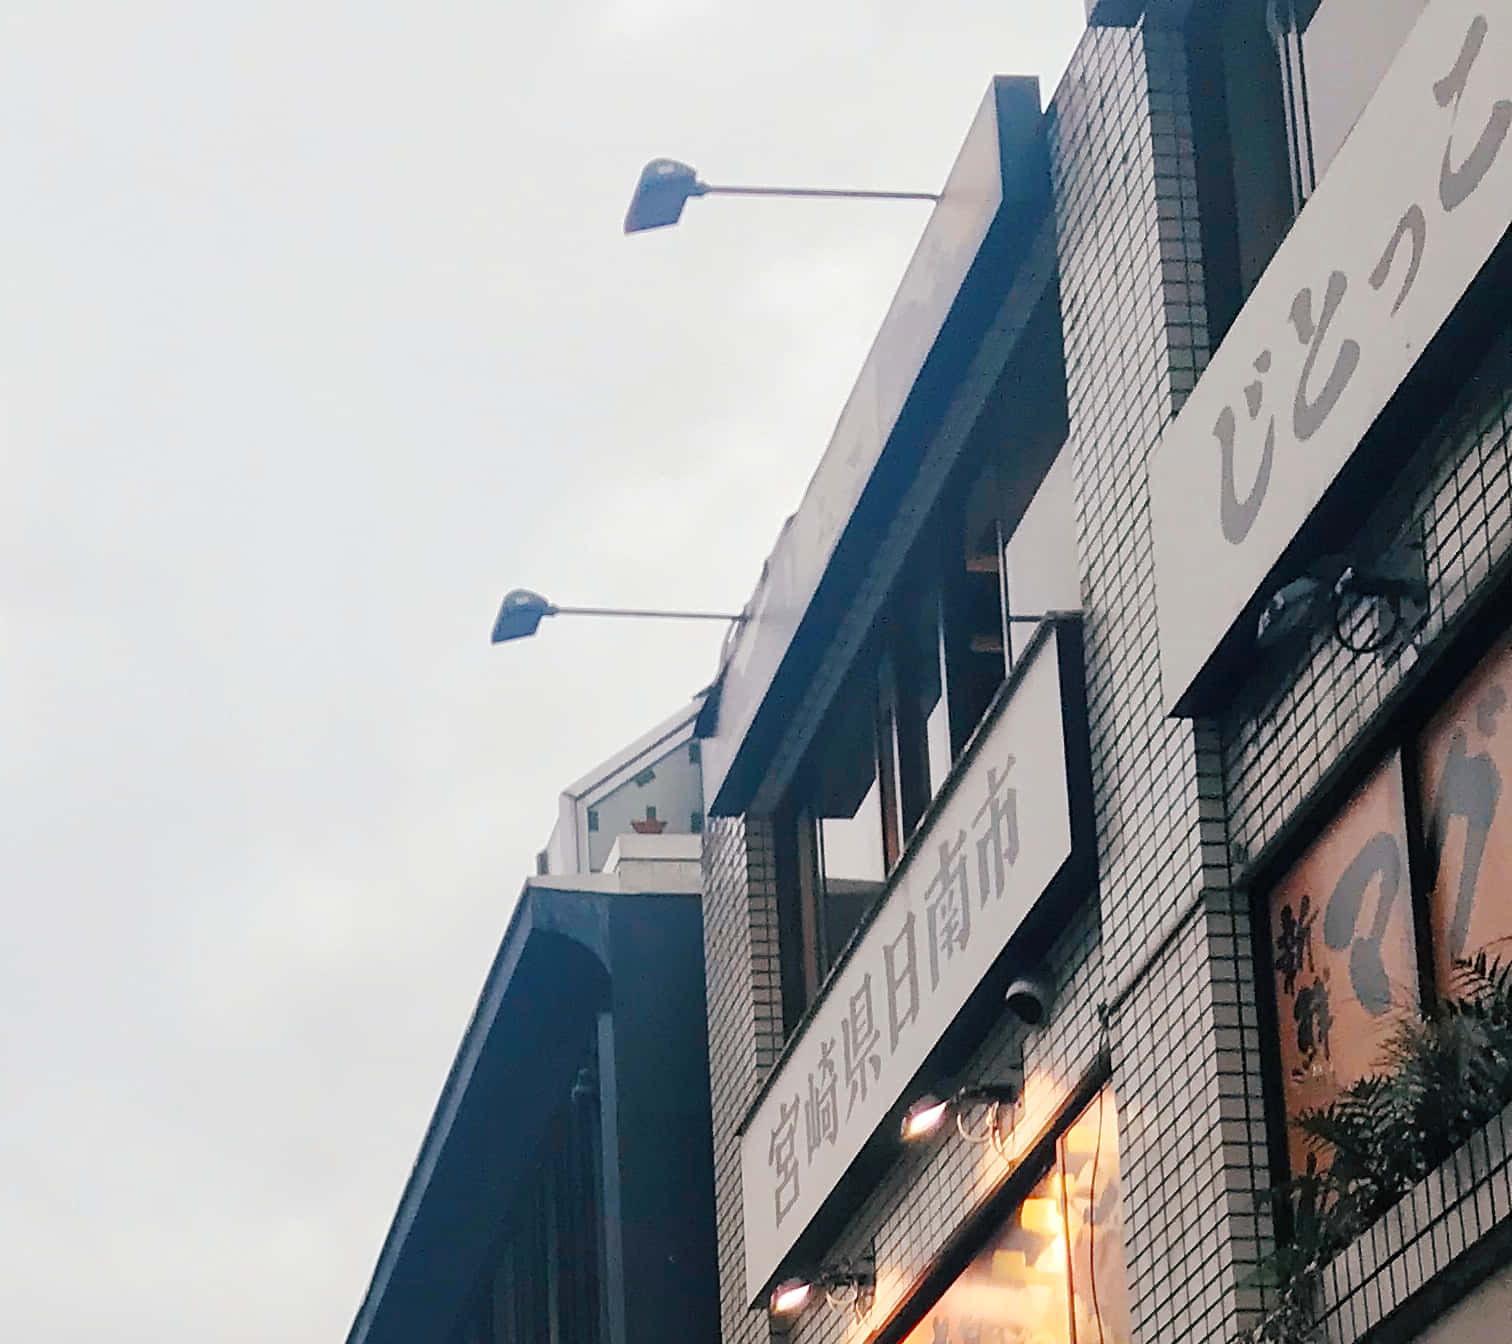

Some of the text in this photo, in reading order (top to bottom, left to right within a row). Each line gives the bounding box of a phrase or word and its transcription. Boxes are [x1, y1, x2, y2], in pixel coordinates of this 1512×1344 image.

[766, 752, 1023, 1232] 宮崎県日南市
